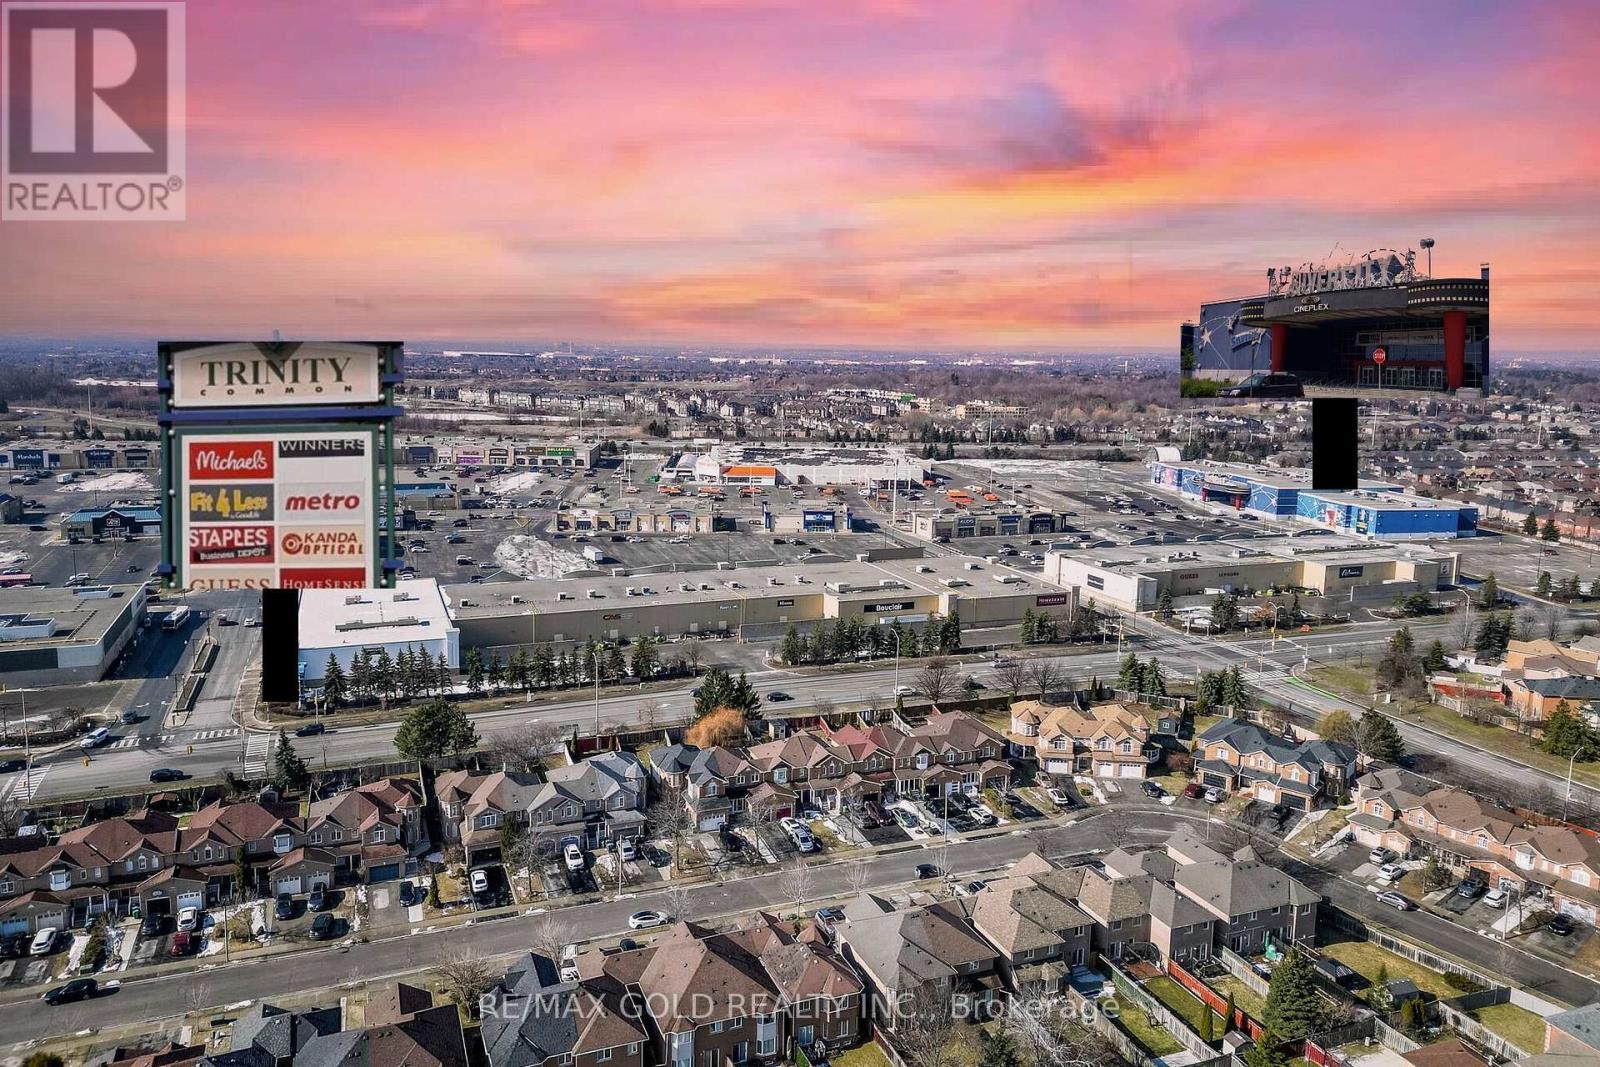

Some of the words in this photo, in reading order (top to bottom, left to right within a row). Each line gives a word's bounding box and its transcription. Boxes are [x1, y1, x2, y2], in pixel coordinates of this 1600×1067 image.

[1293, 303, 1329, 313] CINEPLEX
[200, 357, 351, 387] TRINITY
[200, 384, 352, 397] COMMON
[280, 439, 366, 451] WINNERS
[195, 449, 268, 471] Michaels
[190, 491, 214, 512] Fit
[215, 488, 231, 517] 4
[233, 489, 268, 511] Less
[285, 493, 360, 510] metro
[189, 528, 268, 547] STAPLES
[304, 532, 358, 543] KANDA
[237, 547, 267, 557] DEPOT
[303, 544, 364, 555] OPTICAL
[875, 604, 903, 612] Bouclair
